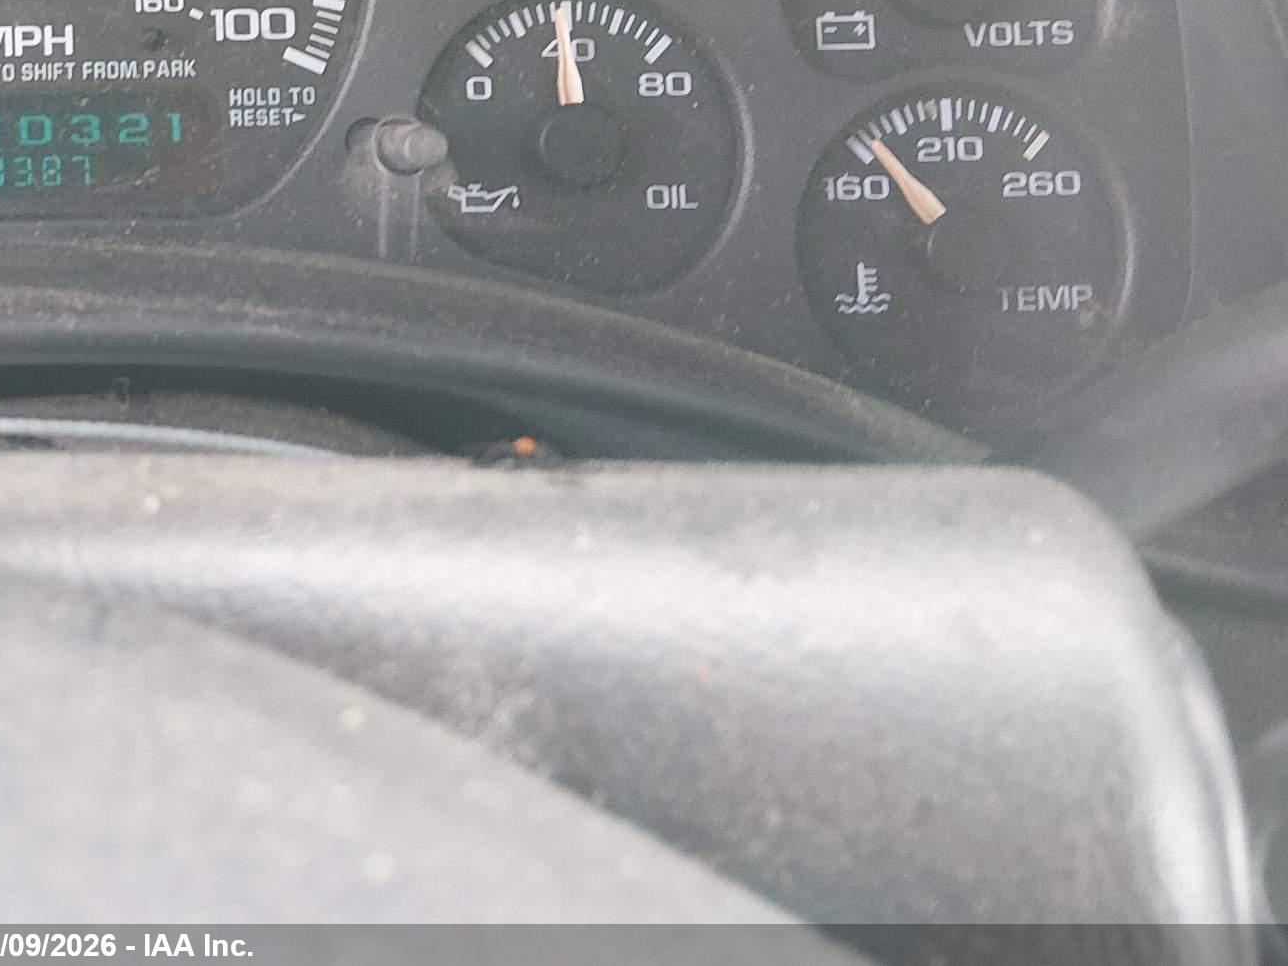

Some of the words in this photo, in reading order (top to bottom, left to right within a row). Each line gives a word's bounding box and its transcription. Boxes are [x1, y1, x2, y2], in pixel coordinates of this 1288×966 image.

[211, 8, 295, 41] 100
[966, 21, 1073, 46] VOLTS
[22, 62, 75, 81] SHIFT
[83, 61, 137, 79] FROM
[144, 60, 195, 78] PARK
[467, 77, 491, 99] 0
[639, 73, 691, 96] 80
[230, 88, 280, 106] HOLD
[289, 87, 314, 104] TO
[229, 108, 292, 126] RESET
[918, 137, 983, 161] 210
[823, 172, 890, 201] 160
[1003, 171, 1080, 196] 260
[647, 185, 697, 208] OIL
[1003, 285, 1092, 310] TEMP
